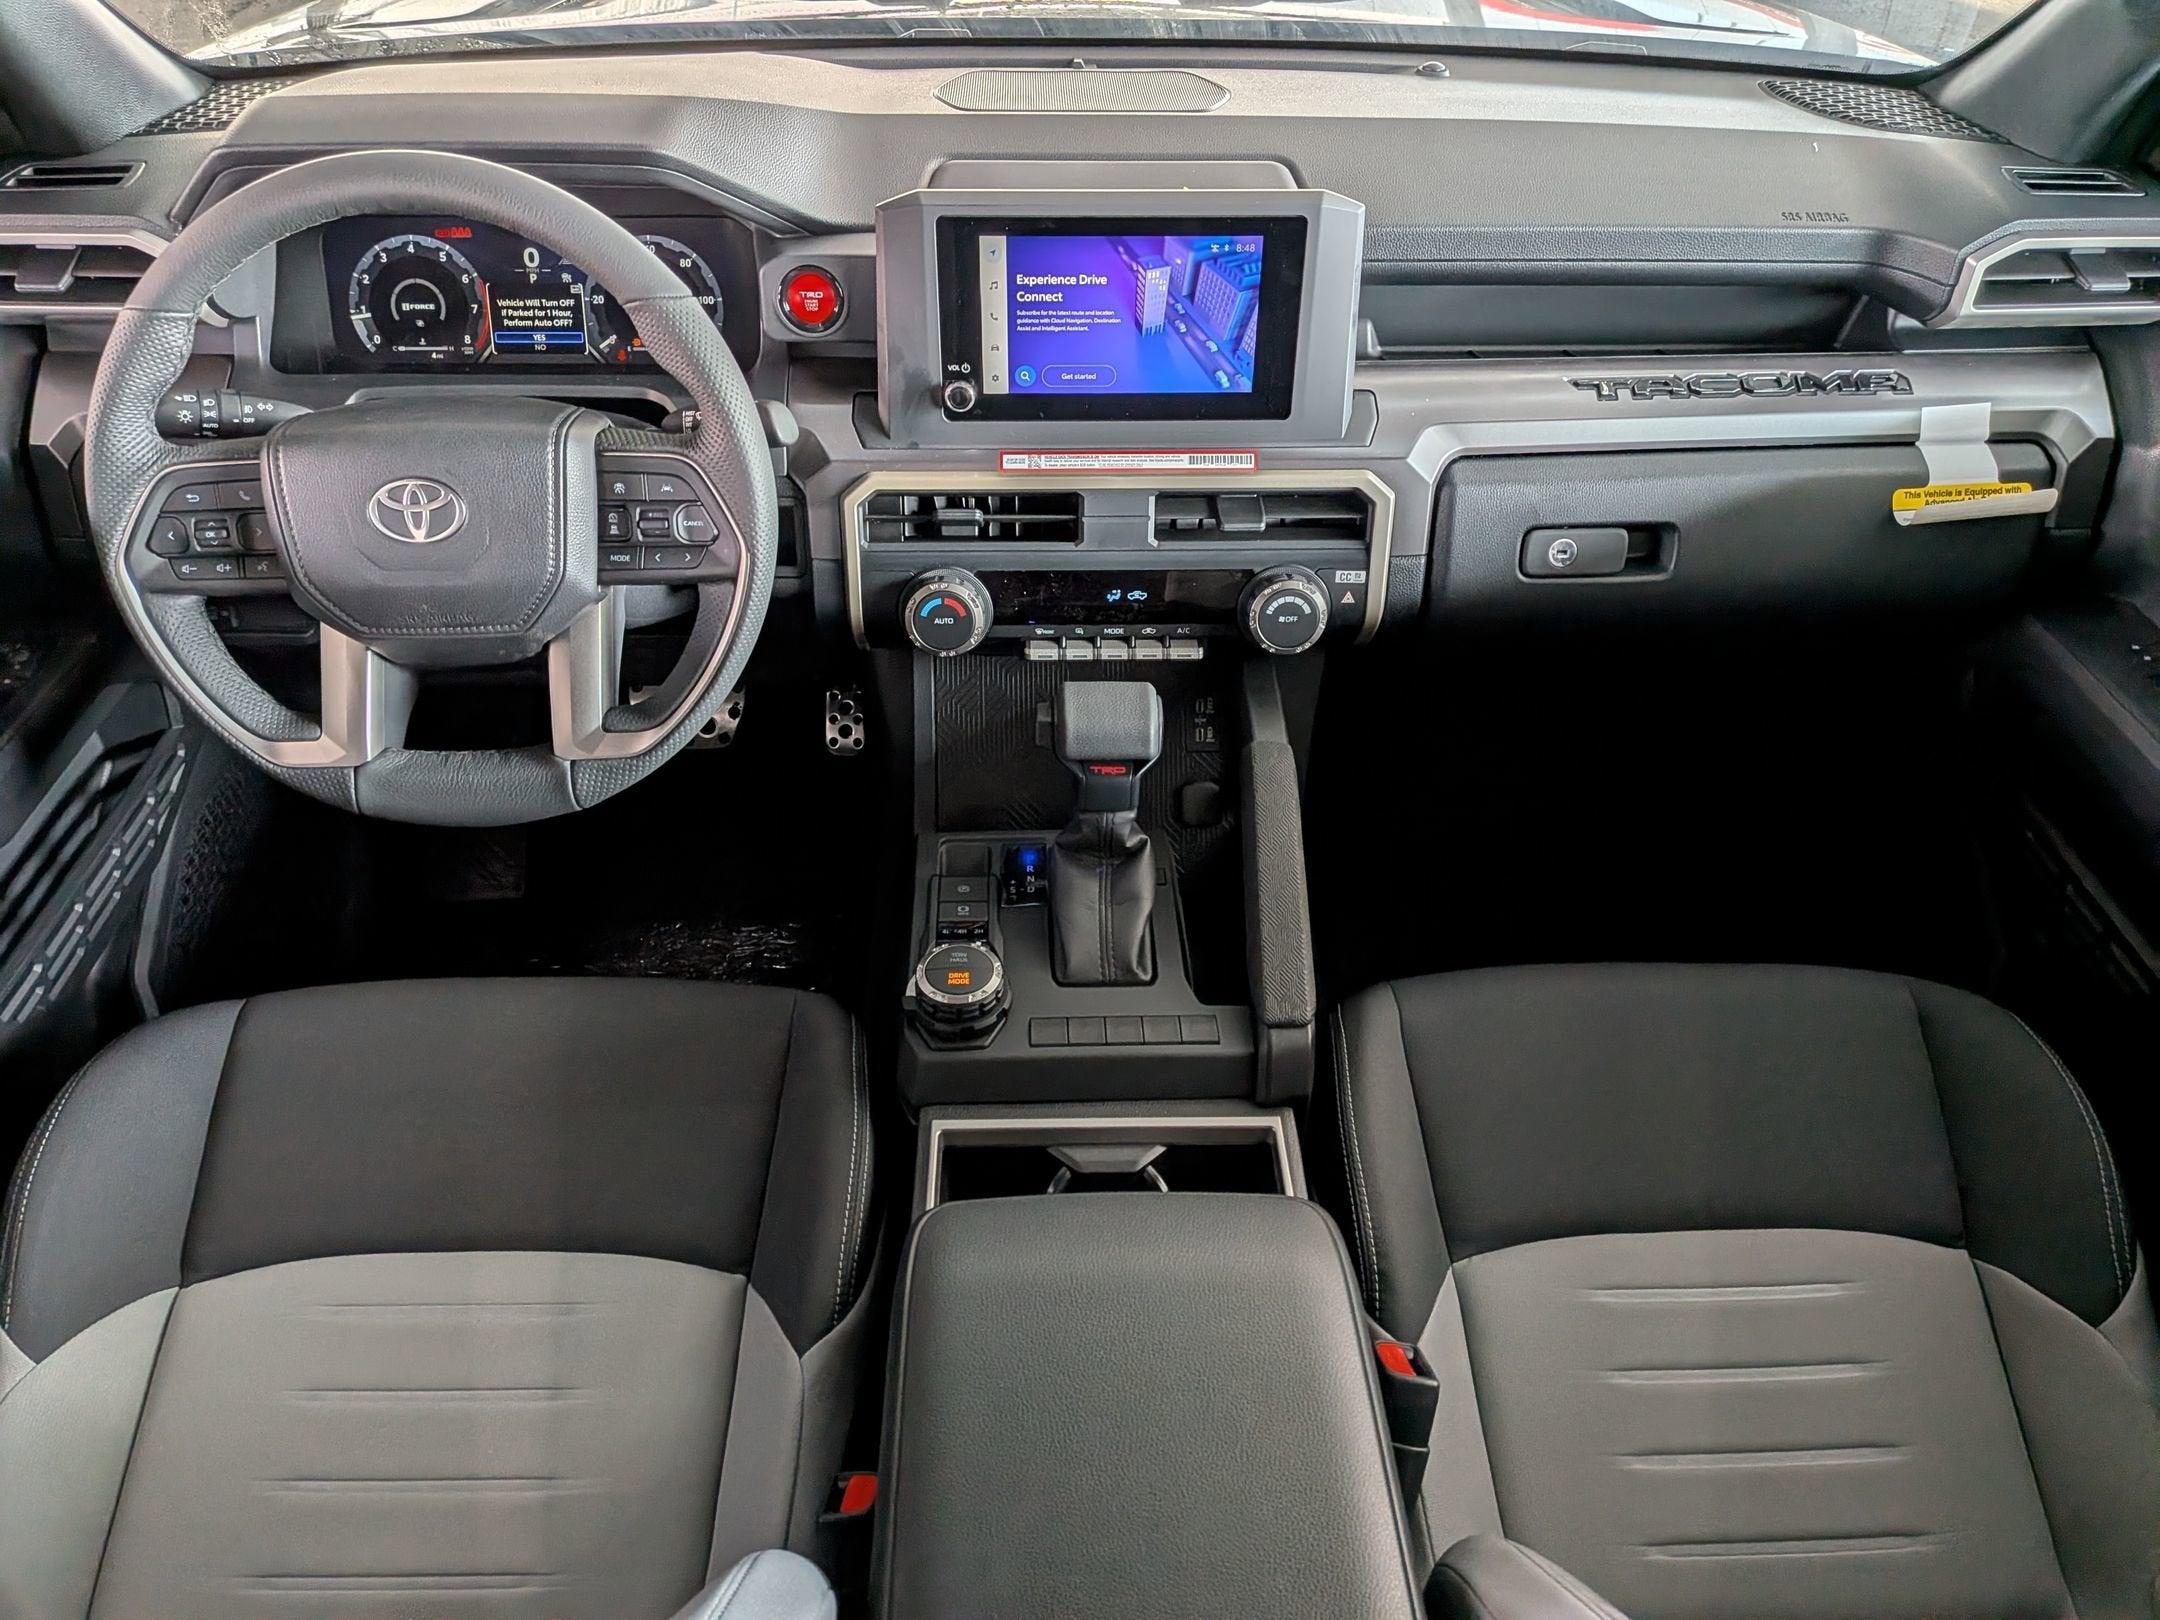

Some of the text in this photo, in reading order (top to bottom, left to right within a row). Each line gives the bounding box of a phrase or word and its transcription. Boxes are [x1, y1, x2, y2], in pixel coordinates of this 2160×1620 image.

[407, 244, 415, 254] 4
[1236, 243, 1256, 253] 8:48
[379, 252, 388, 263] 3
[439, 251, 447, 262] 5
[523, 247, 540, 268] 0
[679, 258, 692, 268] 80
[362, 274, 370, 285] 2
[461, 274, 469, 283] 6
[529, 273, 538, 284] P
[1016, 273, 1108, 287] Experience Drive
[592, 295, 605, 305] 20
[799, 291, 824, 299] TRD
[1016, 291, 1064, 302] Connect
[496, 299, 575, 307] Vehicle Will Turn OFF
[699, 296, 714, 305] 100
[470, 304, 478, 314] 7
[508, 309, 534, 317] Parked
[534, 309, 546, 317] for
[552, 309, 573, 318] Hour,
[503, 319, 573, 327] Perform Auto OFF?
[373, 334, 381, 344] 0
[464, 334, 472, 344] 8
[1563, 370, 1915, 402] TACOMA
[1904, 491, 1921, 499] This
[1923, 489, 1953, 498] Vehicle
[1954, 488, 1962, 497] is
[1964, 486, 2003, 499] Equipped
[2004, 486, 2022, 494] with
[610, 554, 631, 562] MODE
[1340, 572, 1352, 582] CC
[934, 617, 954, 625] AUTO
[1089, 765, 1127, 775] TRD
[1026, 865, 1035, 873] R
